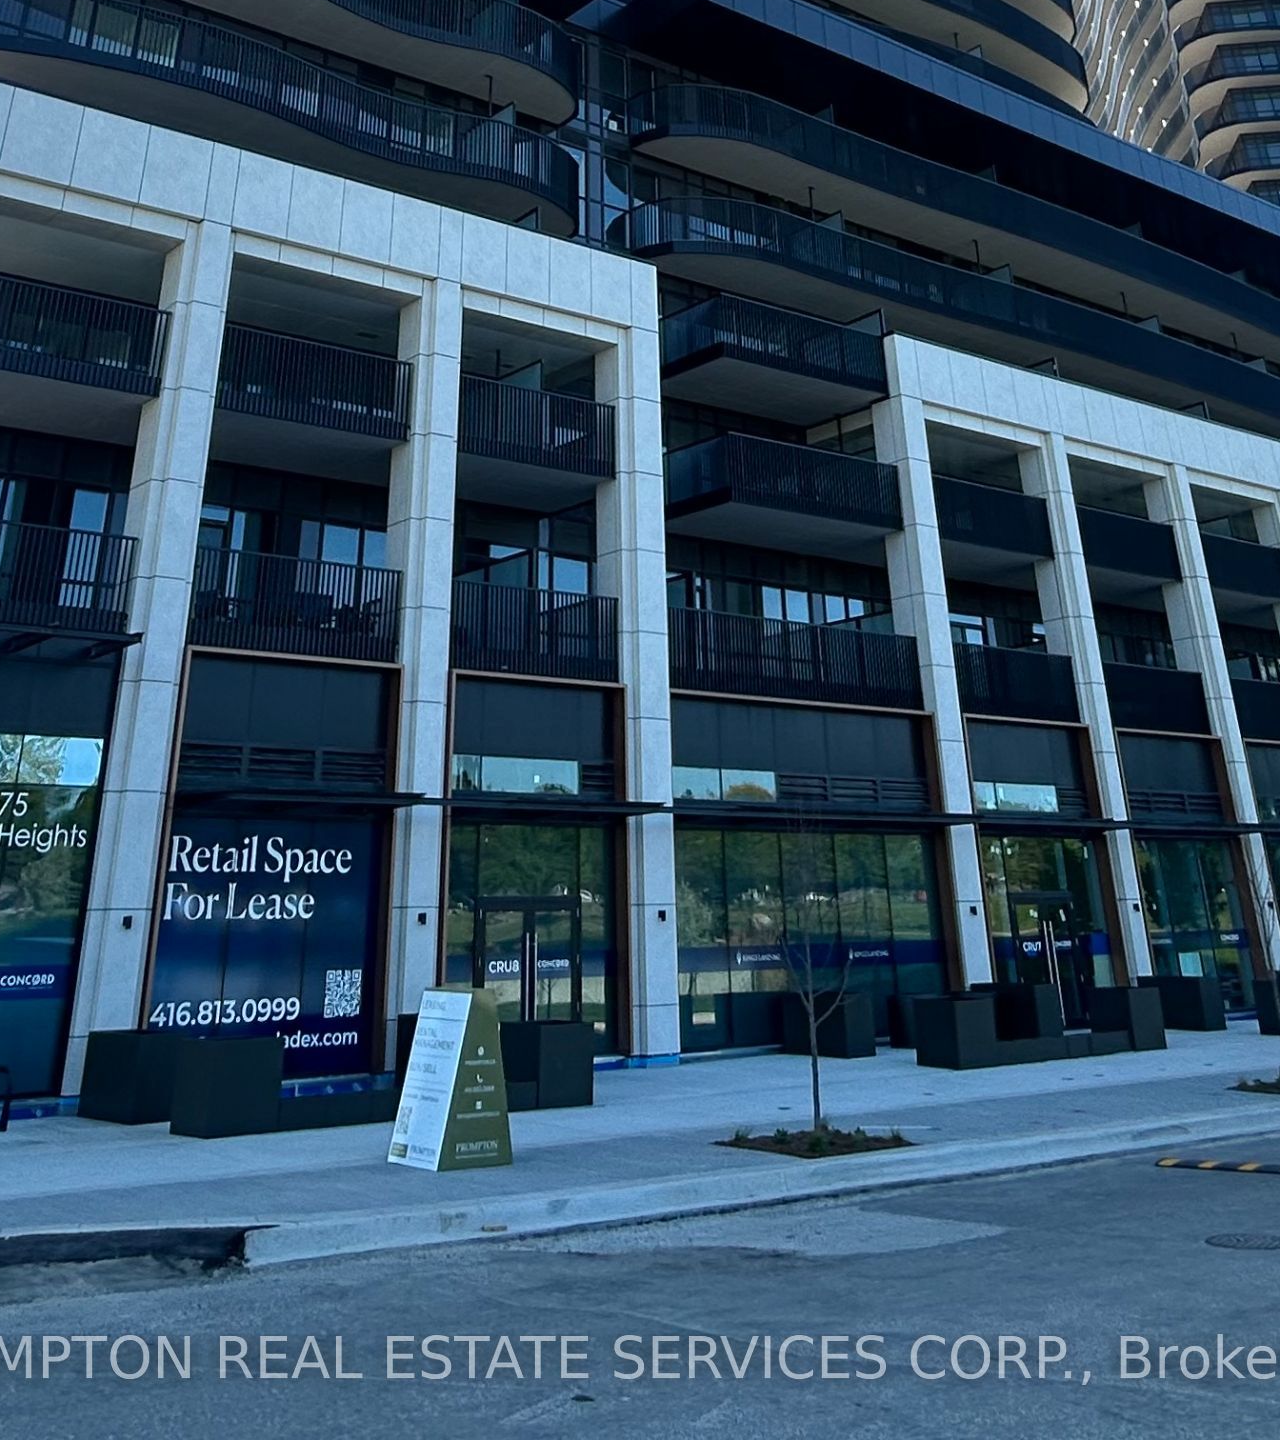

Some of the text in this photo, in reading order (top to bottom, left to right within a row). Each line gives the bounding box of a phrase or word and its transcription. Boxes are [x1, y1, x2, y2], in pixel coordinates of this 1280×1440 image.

[169, 835, 352, 883] Retail Space
[163, 882, 315, 920] For Lease
[0, 973, 55, 987] CONCORD
[488, 960, 519, 973] CRU8
[149, 997, 300, 1027] 416.813.0999
